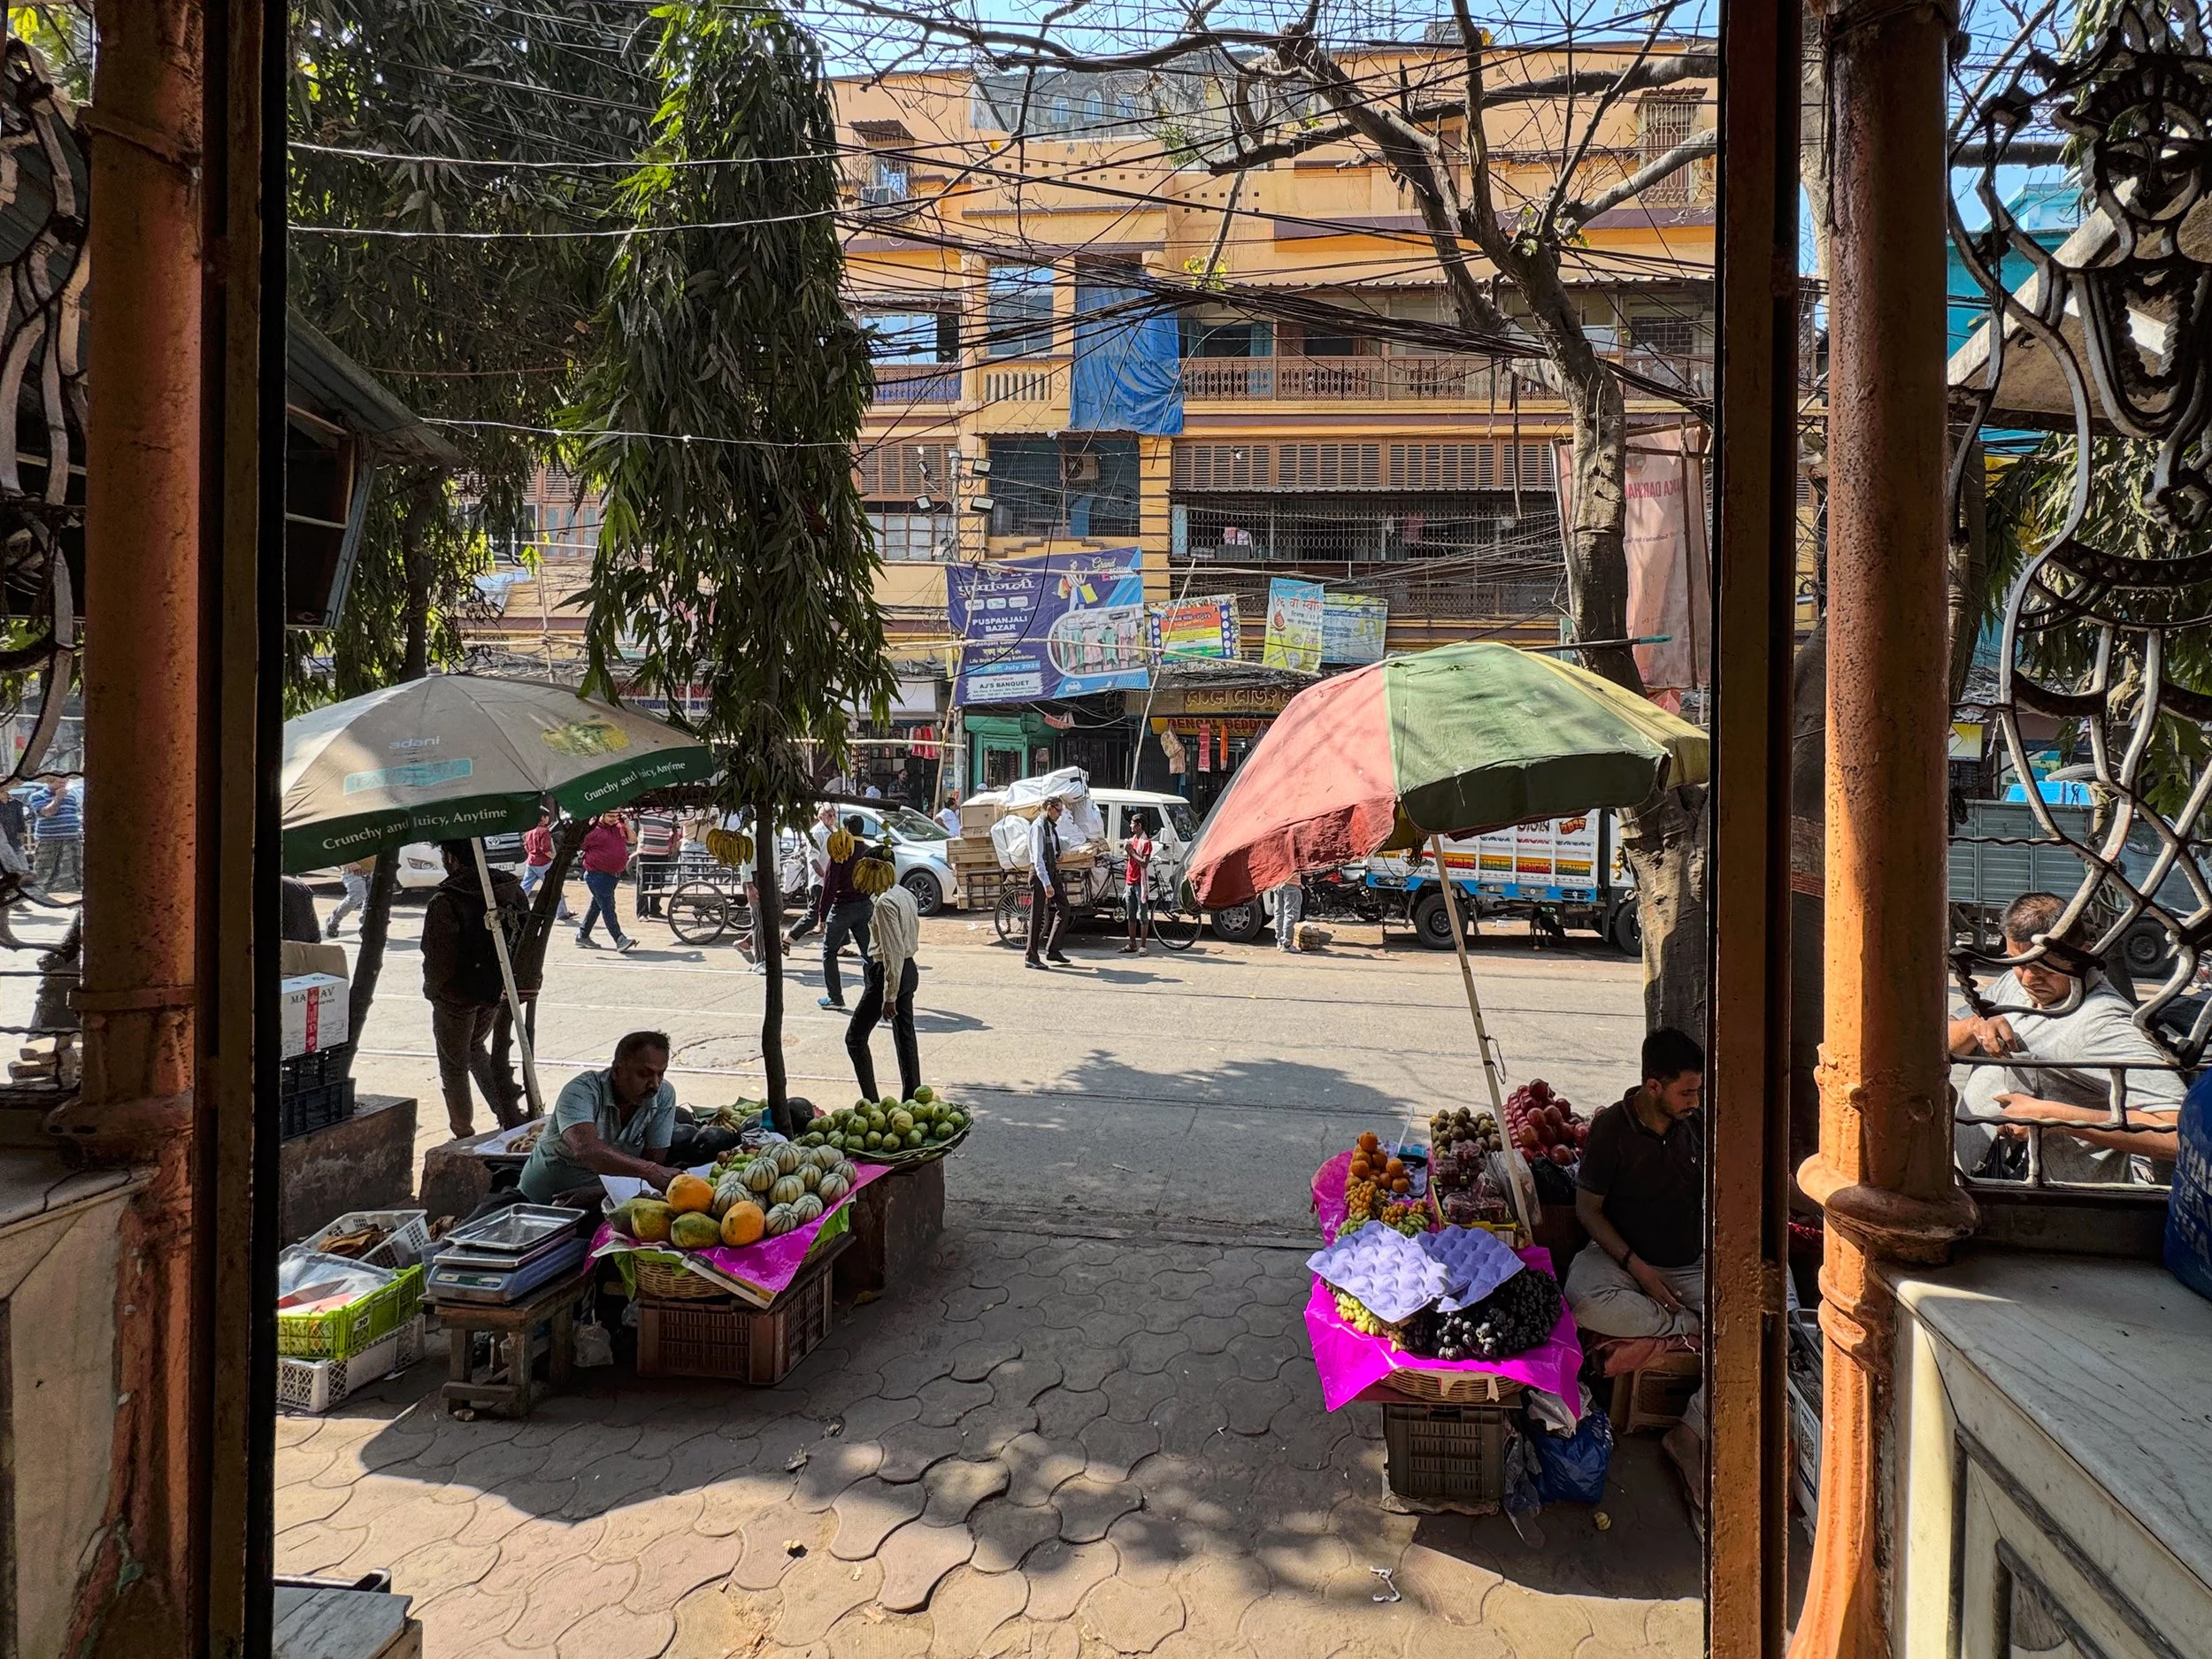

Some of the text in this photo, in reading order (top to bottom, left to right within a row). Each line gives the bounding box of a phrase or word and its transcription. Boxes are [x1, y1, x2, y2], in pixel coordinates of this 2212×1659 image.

[972, 616, 1028, 626] PUSPANJALI
[1224, 718, 1274, 730] BEDDIN
[388, 735, 441, 750] adani
[584, 781, 618, 802] Crunchy
[619, 771, 637, 787] and
[322, 809, 508, 850] Crunchy and Juicy, Anytime
[290, 987, 335, 1005] MAAV
